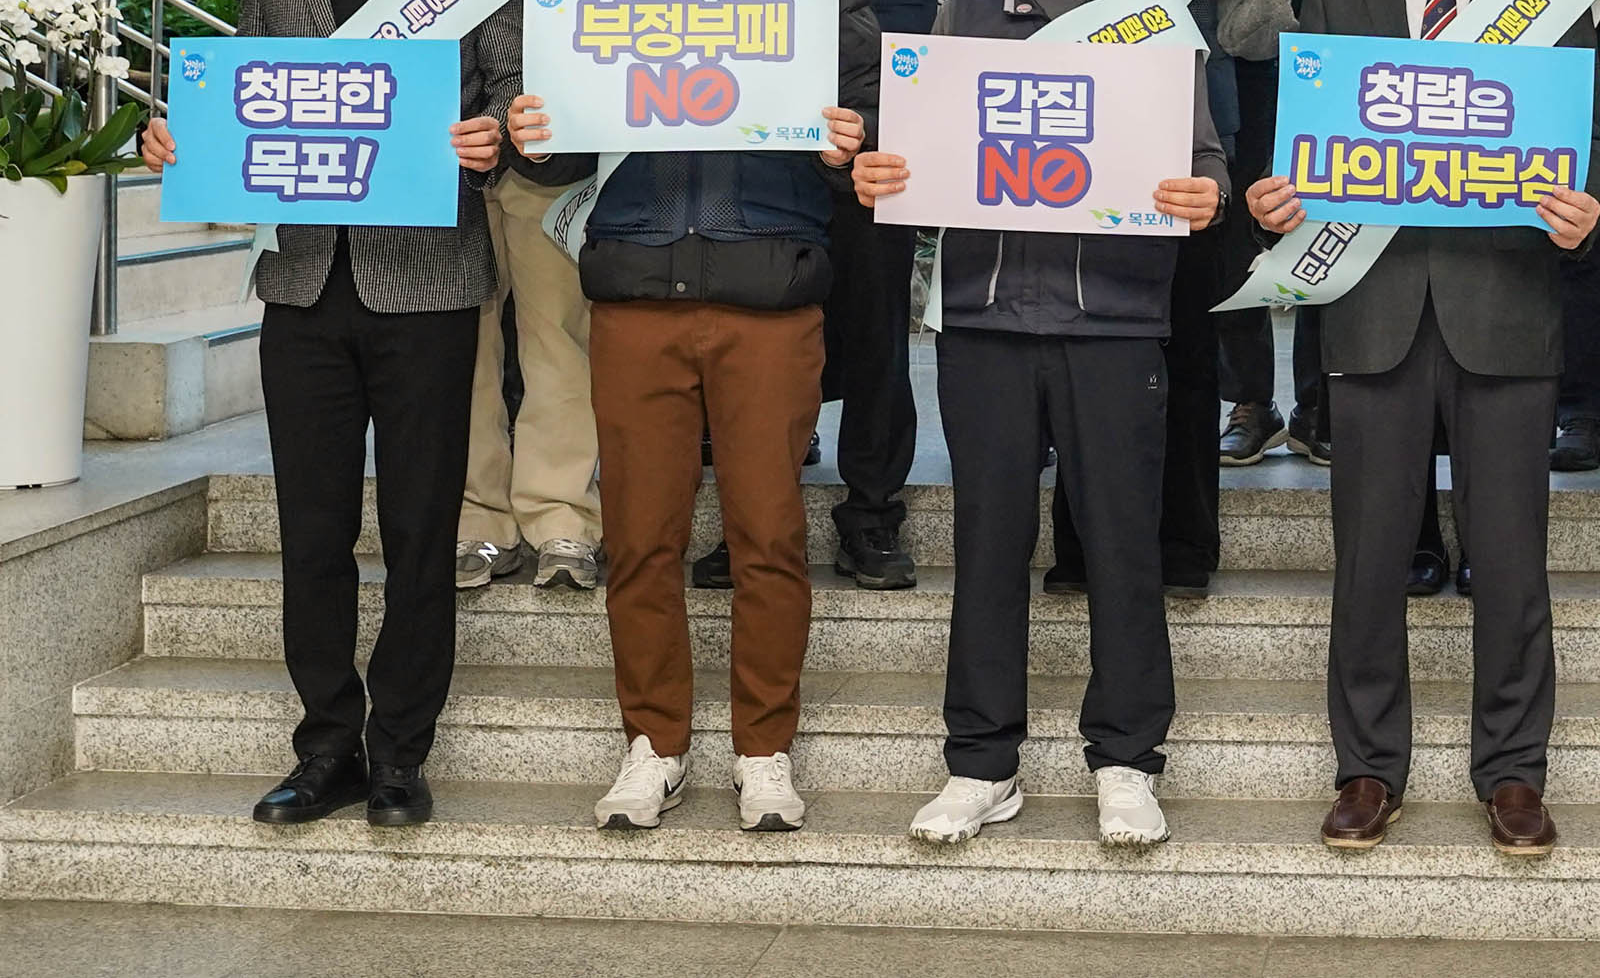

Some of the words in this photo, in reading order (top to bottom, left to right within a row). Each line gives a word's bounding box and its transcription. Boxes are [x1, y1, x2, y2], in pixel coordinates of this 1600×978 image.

[579, 2, 789, 58] 부정부패
[239, 67, 391, 124] 청렴한
[632, 68, 735, 122] NO
[983, 78, 1088, 138] 갑질
[1363, 68, 1508, 132] 청렴은
[776, 127, 821, 142] 목포시
[247, 140, 373, 197] 목포!
[983, 146, 1087, 204] NO
[1295, 141, 1399, 200] 나의
[1411, 150, 1571, 204] 자부심
[1128, 212, 1174, 228] 목포시
